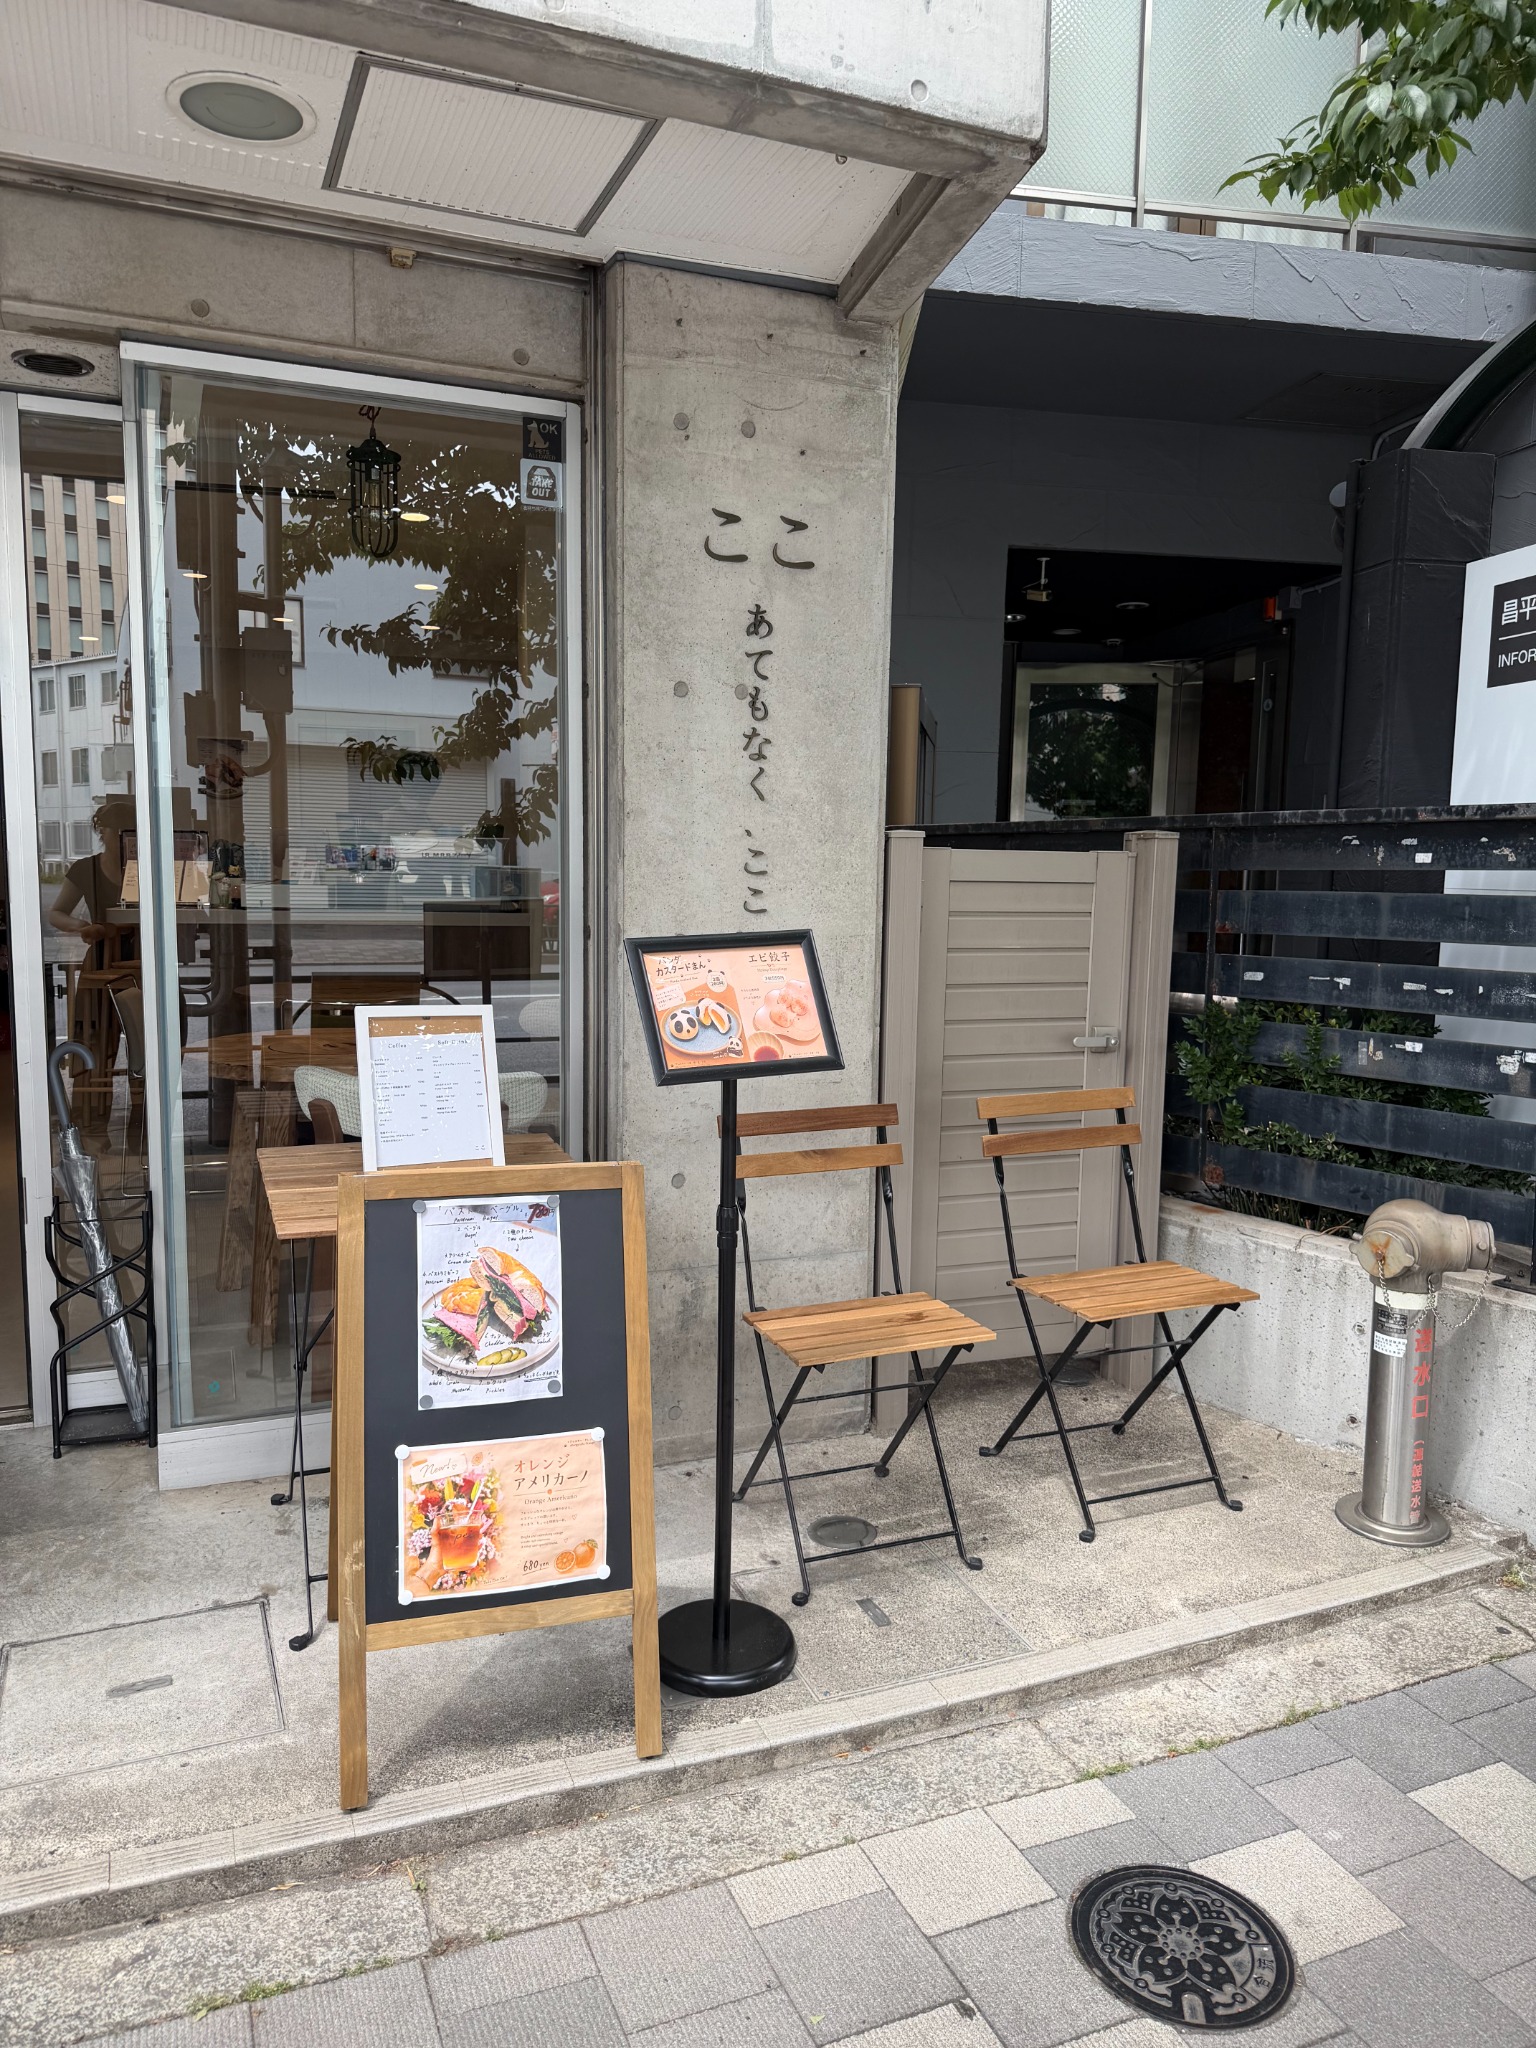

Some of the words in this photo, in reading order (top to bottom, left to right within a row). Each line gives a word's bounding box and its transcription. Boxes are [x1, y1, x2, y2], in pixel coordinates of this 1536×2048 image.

[540, 422, 558, 435] OK
[531, 488, 551, 497] OUT
[704, 507, 815, 570] ここ
[1501, 594, 1536, 626] 昌平
[749, 951, 790, 963] エビ餃子
[656, 961, 706, 977] カスタードまん
[1411, 1327, 1433, 1419] 送水口
[514, 1454, 570, 1474] オレンジ
[514, 1470, 588, 1490] アメリカーノ
[523, 1560, 539, 1572] 680
[539, 1562, 549, 1570] yen
